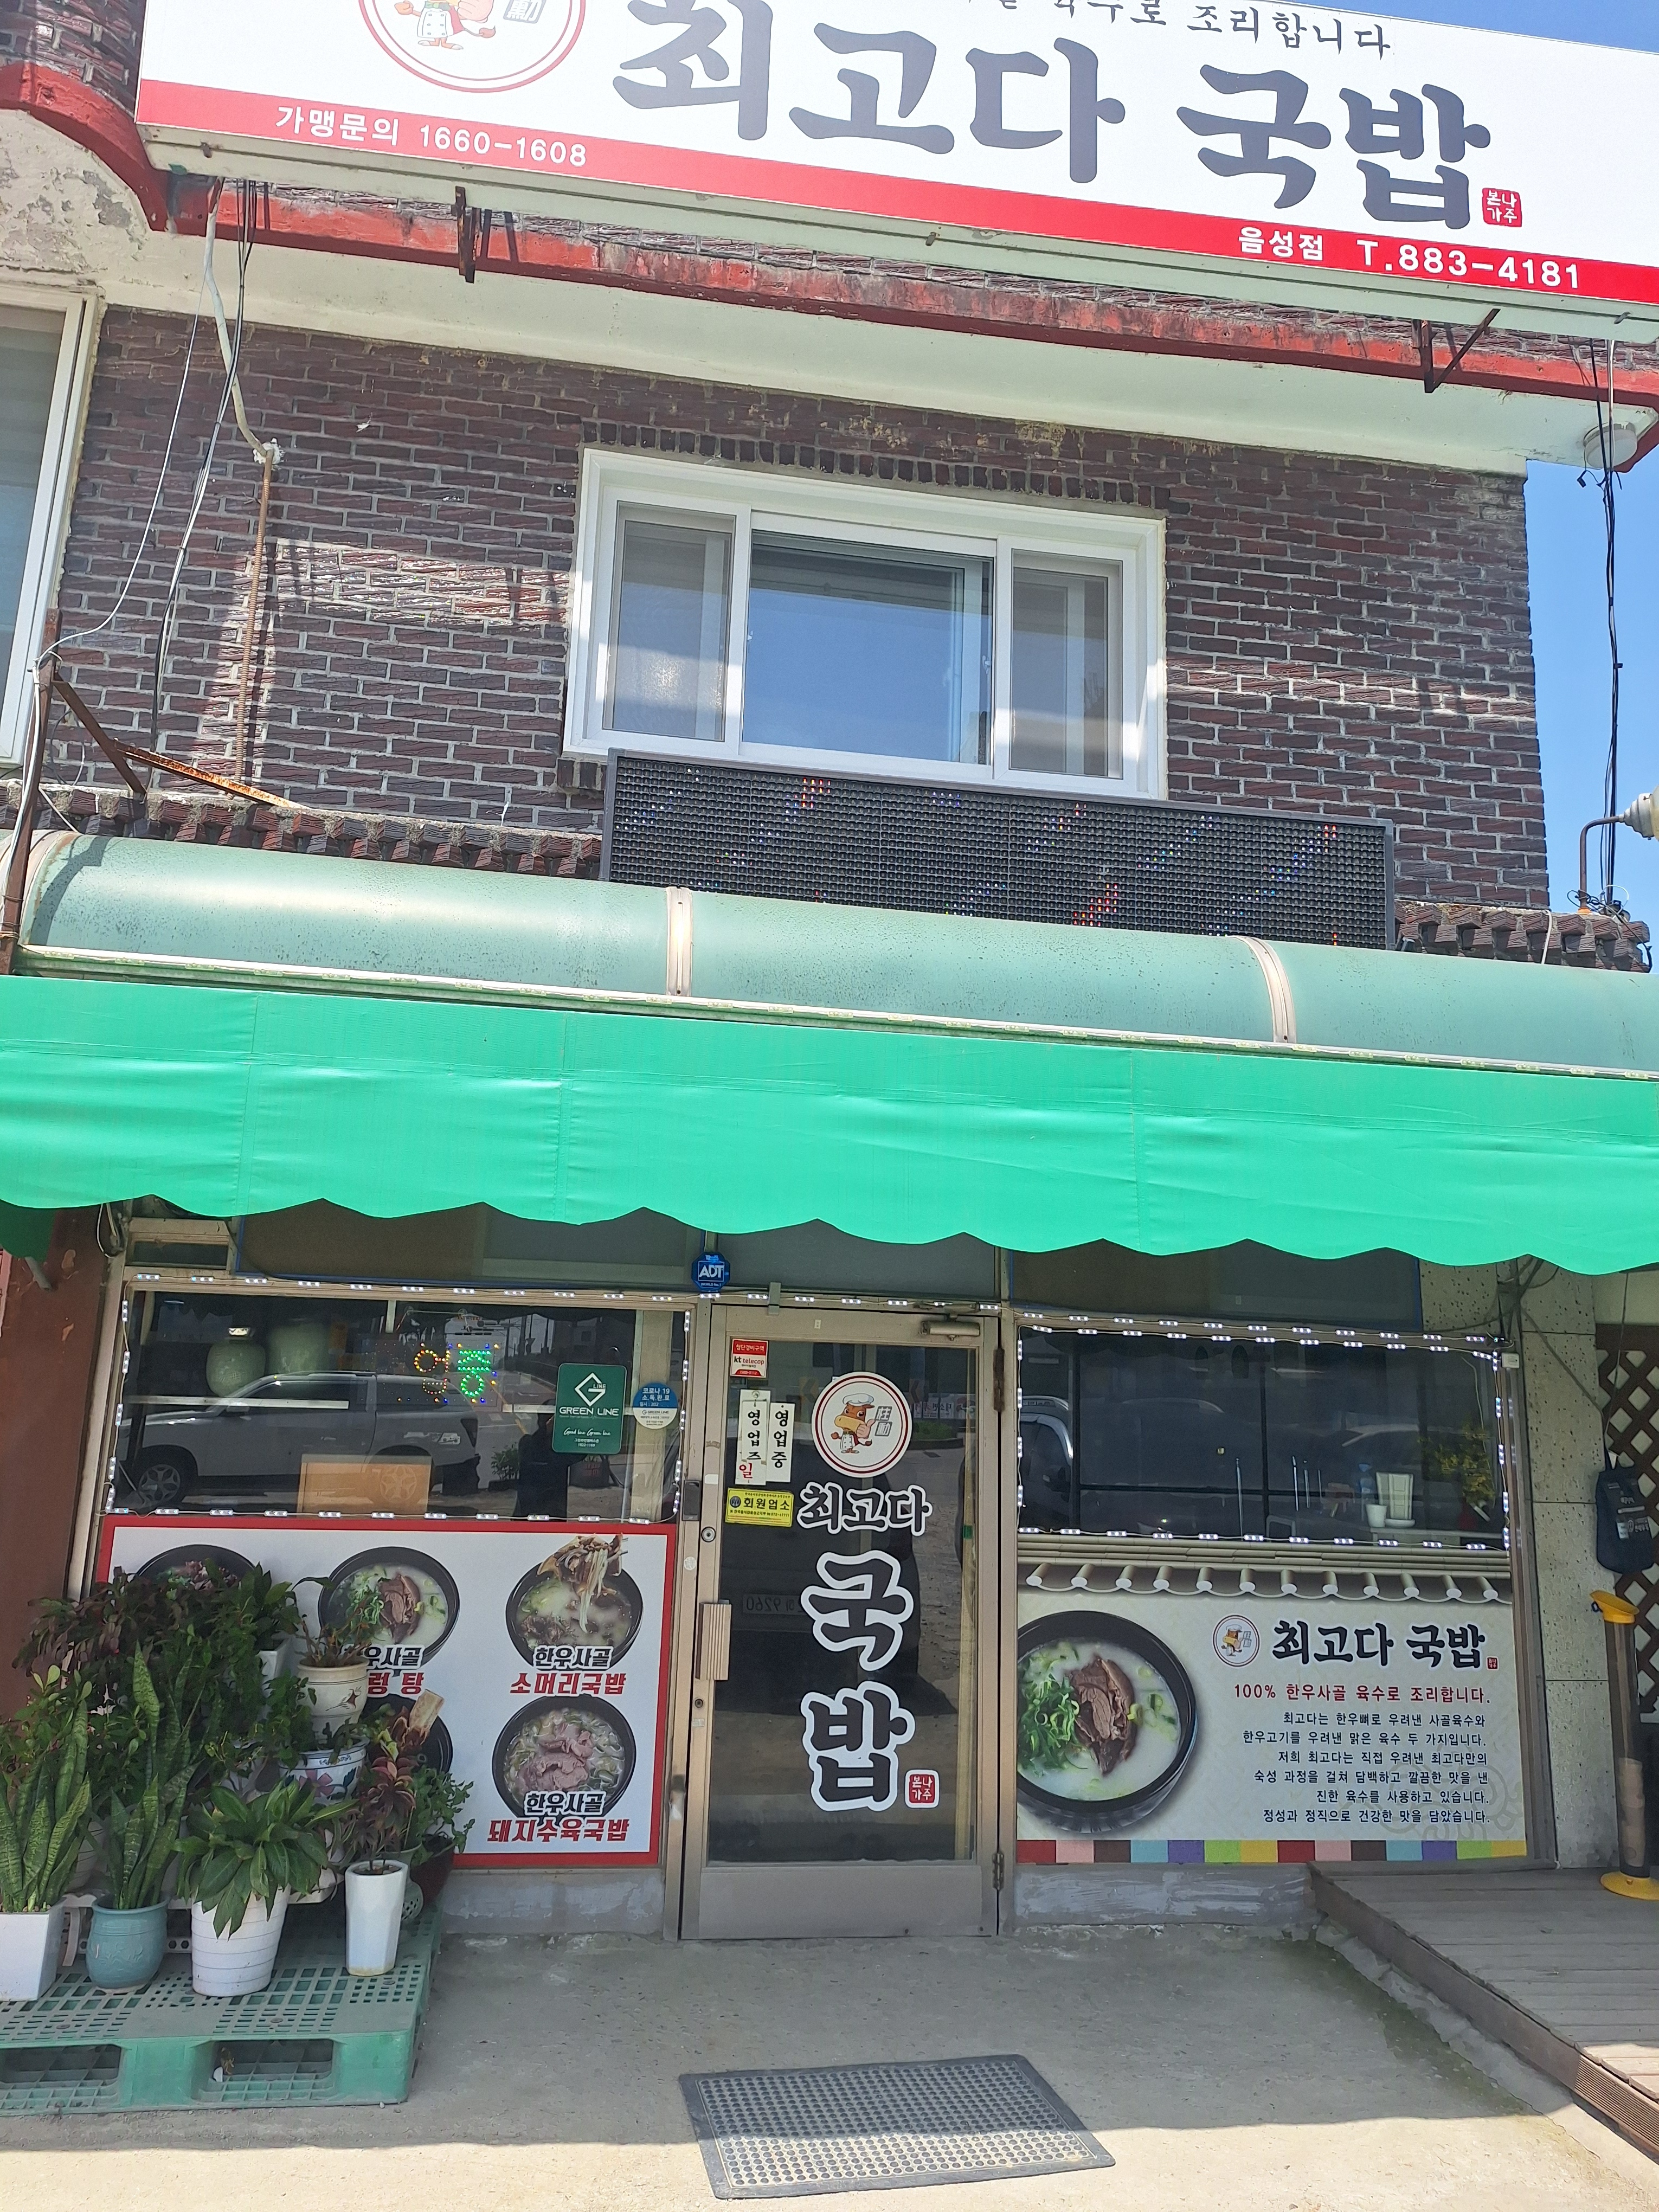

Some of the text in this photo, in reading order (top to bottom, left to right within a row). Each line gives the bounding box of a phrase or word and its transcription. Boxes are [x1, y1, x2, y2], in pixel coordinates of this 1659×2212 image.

[1186, 6, 1391, 60] 조리합니다
[613, 0, 1491, 230] 최고다 국밥
[275, 105, 587, 166] 가맹문의 1660-1608
[1238, 227, 1580, 289] 음성점 T.883-4181
[698, 1264, 723, 1278] ADT
[743, 1358, 764, 1366] telecop
[559, 1406, 619, 1416] GREEN LINE
[770, 1410, 789, 1468] 영업중
[743, 1497, 790, 1511] 회원업소
[798, 1482, 933, 1536] 최고다
[1272, 1619, 1486, 1668] 최고다 국밥
[345, 1645, 423, 1667] 우사골
[536, 1647, 612, 1669] 한우사골
[510, 1672, 627, 1695] 소머리국밥
[800, 1549, 915, 1812] 국밥
[1234, 1683, 1490, 1703] 100% 한우사골 육수로 조리합니다.
[1283, 1712, 1486, 1727] 최고다는 한우뼈로 우려낸 사골육수와
[1243, 1730, 1487, 1746] 한우고기를 우려낸 맑은 육수 두 가지입니다.
[1278, 1751, 1487, 1765] 저희 최고다는 직접 우려낸 최고다만의
[1254, 1770, 1488, 1784] 숙성 과정을 걸쳐 담백하고 깔끔한 맛을 낸
[526, 1793, 605, 1815] 한우사골
[1317, 1790, 1489, 1804] 진한 육수를 사용하고 있습니다.
[1263, 1809, 1490, 1823] 정성과 정직으로 건강한 맛을 담았습니다.
[488, 1819, 630, 1843] 돼지수육국밥
